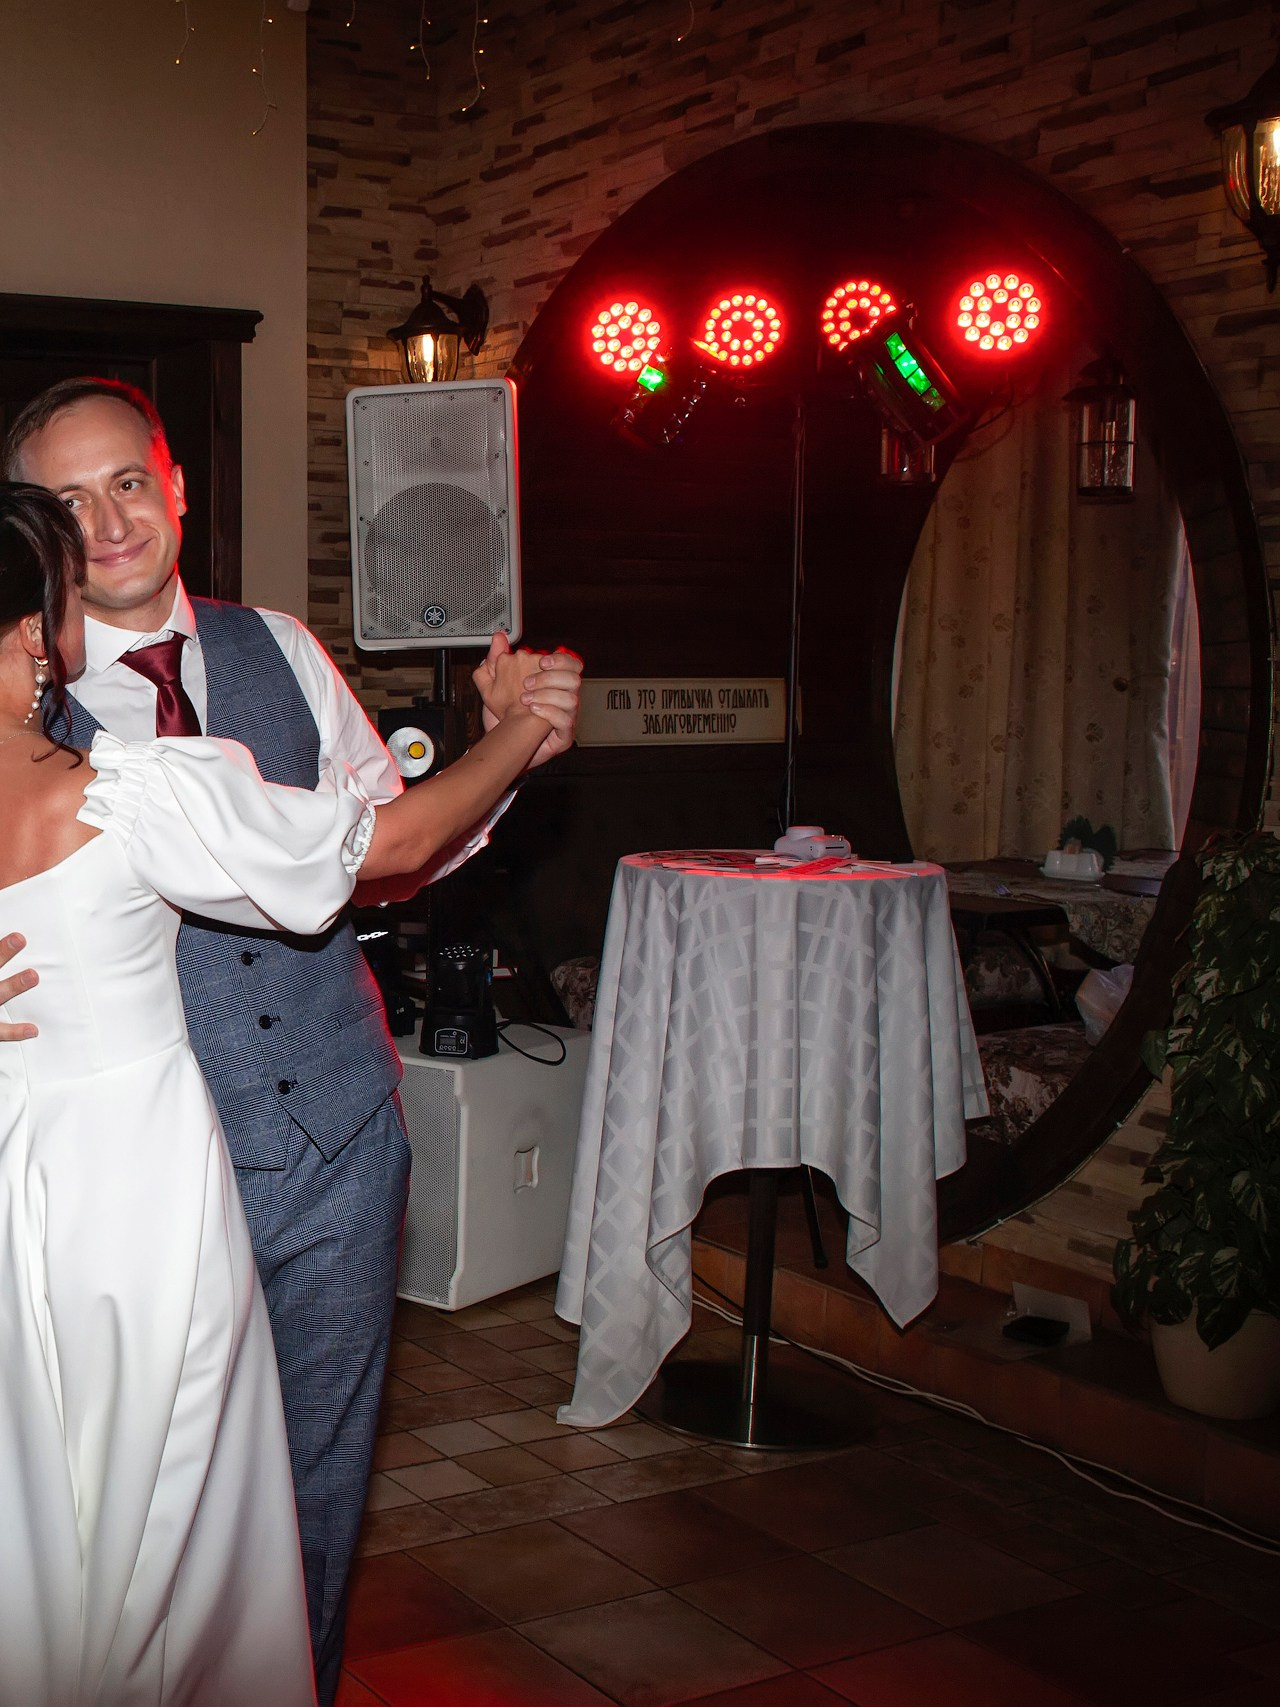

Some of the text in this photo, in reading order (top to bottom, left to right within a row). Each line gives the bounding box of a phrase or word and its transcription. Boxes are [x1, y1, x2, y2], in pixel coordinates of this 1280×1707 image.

[606, 688, 770, 710] ЛЕНЬ ЭТО ПРИВЫЧКА ОТДЫХАТЬ
[641, 713, 737, 735] ЗАБЛАГОВРЕМЕННО
